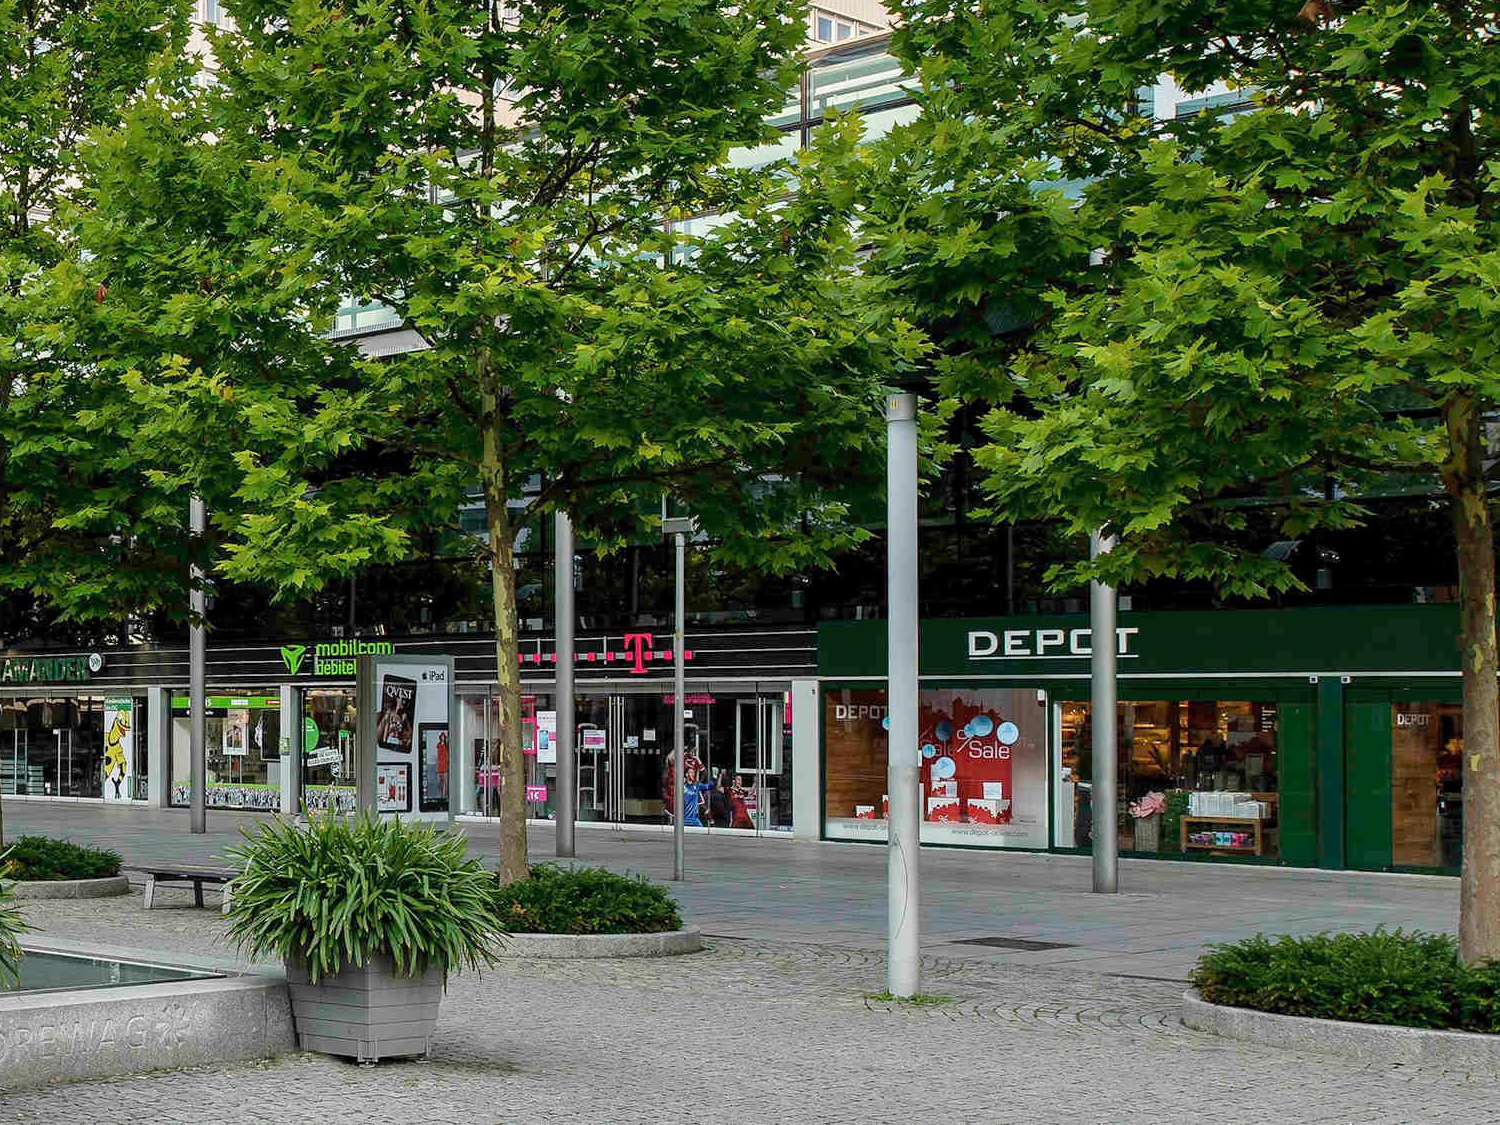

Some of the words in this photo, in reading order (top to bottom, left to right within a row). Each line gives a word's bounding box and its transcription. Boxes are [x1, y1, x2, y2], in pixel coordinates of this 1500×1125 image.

[315, 639, 392, 656] mobilcom
[968, 627, 1139, 656] DEPOT
[316, 659, 357, 675] debitel
[429, 671, 445, 681] iPad
[1397, 714, 1430, 725] DEPOT
[969, 740, 1010, 759] Sale
